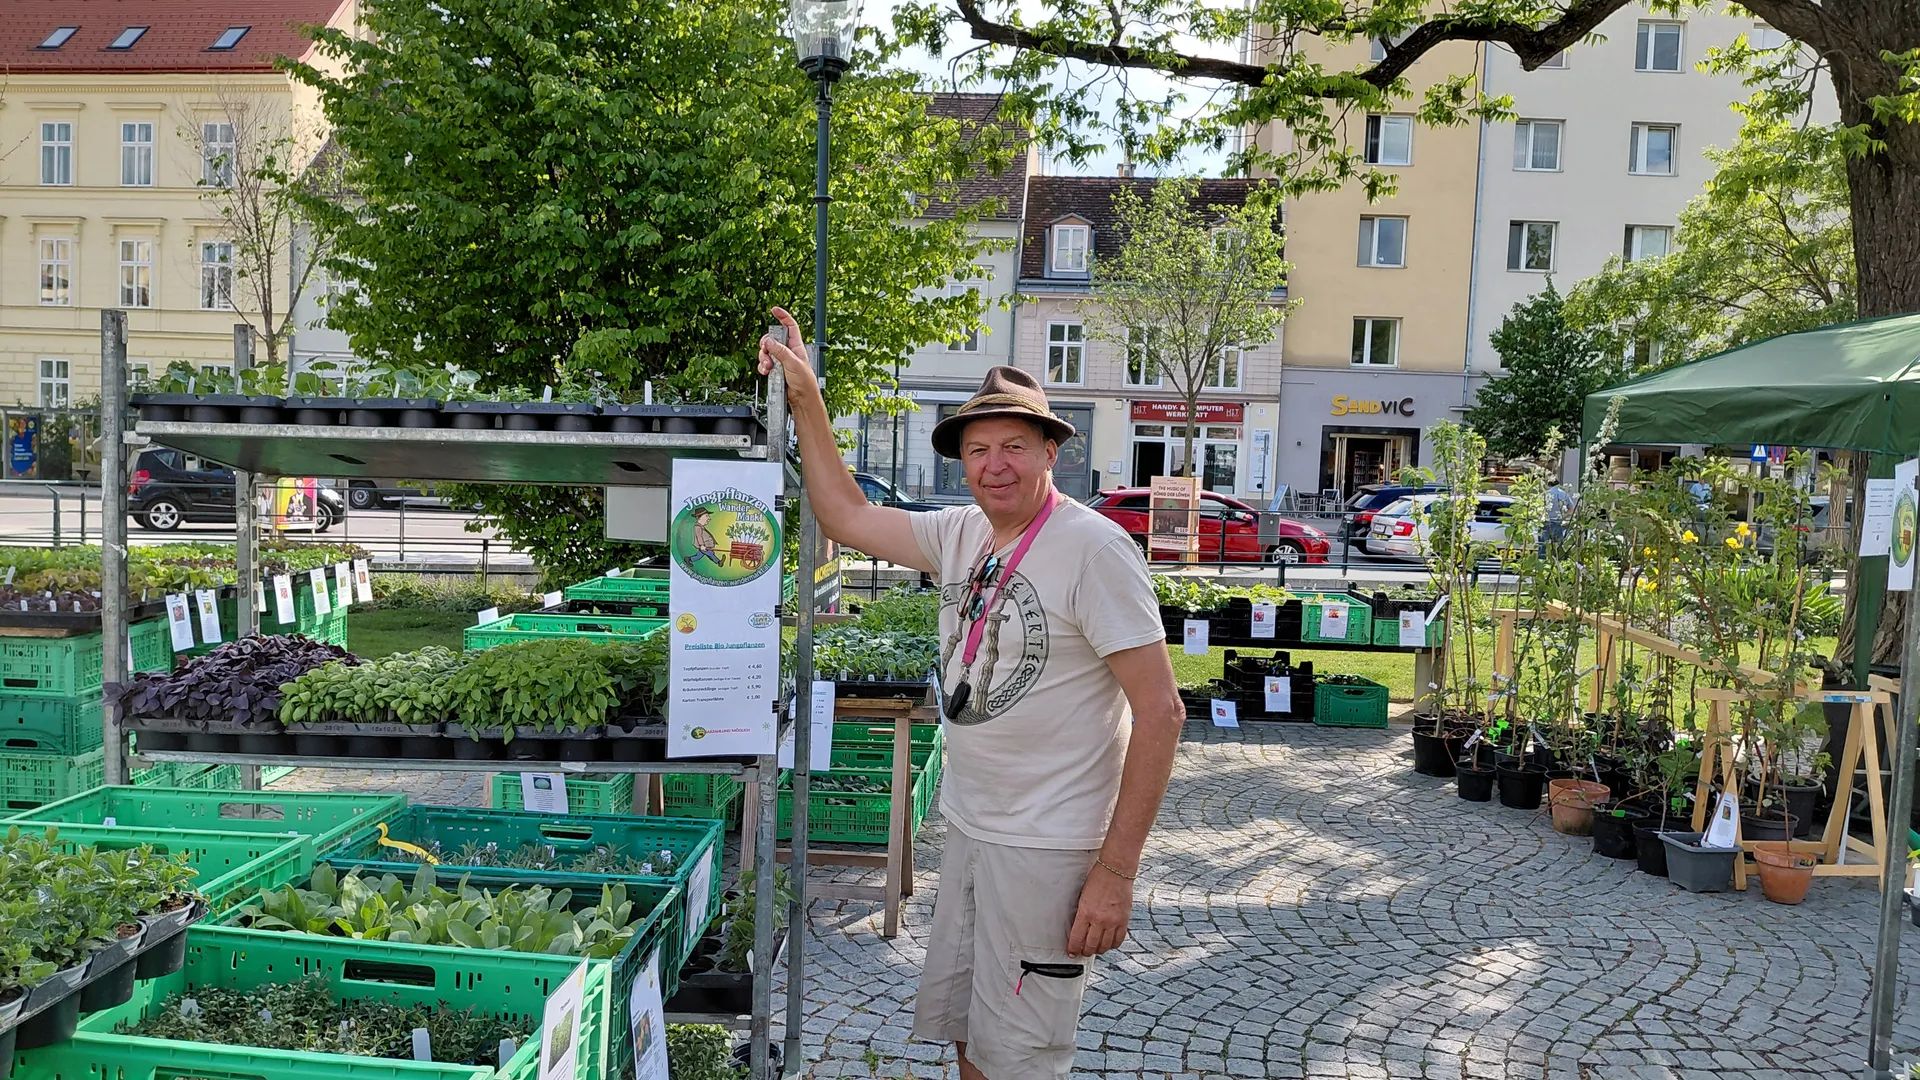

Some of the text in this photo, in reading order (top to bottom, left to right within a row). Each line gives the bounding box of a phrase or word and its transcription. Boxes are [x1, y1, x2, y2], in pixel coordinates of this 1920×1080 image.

[1187, 404, 1224, 412] MPUTER
[1166, 410, 1208, 418] WERKATT
[684, 486, 769, 511] Jungpflanzen
[718, 502, 751, 513] Wander
[735, 511, 764, 522] Markt
[1021, 594, 1044, 664] WERTE
[685, 643, 713, 651] Preisliste
[726, 642, 766, 650] Jungpflanzen
